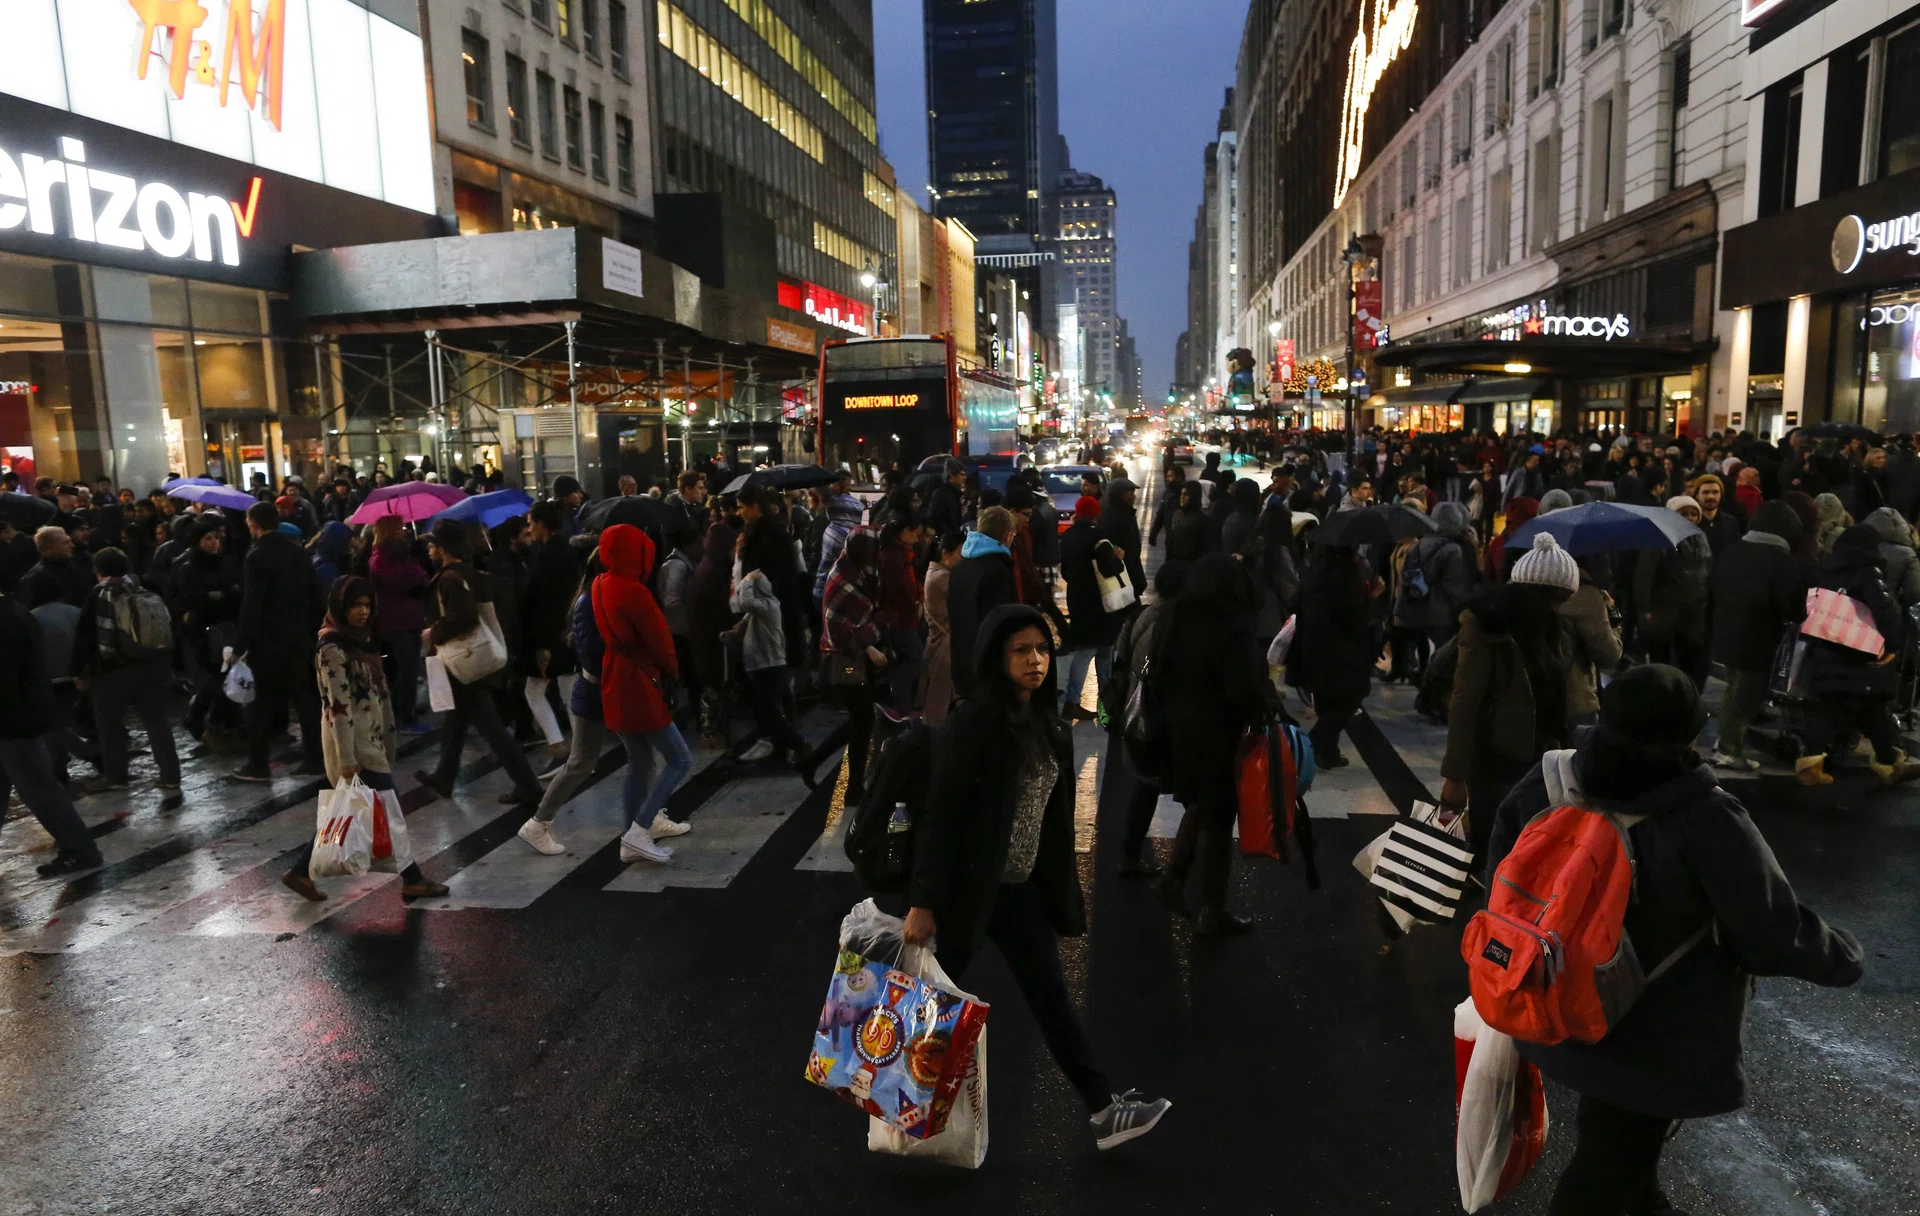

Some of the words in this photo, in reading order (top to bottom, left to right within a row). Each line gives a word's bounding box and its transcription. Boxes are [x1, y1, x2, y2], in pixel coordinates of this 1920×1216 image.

[128, 0, 287, 133] H&M
[1543, 312, 1630, 342] macy's
[845, 396, 893, 409] DOWNTOWN
[895, 394, 918, 407] LOOP
[1405, 860, 1426, 872] SEPHORA
[873, 1008, 899, 1024] MACY'S
[867, 1023, 892, 1049] 90
